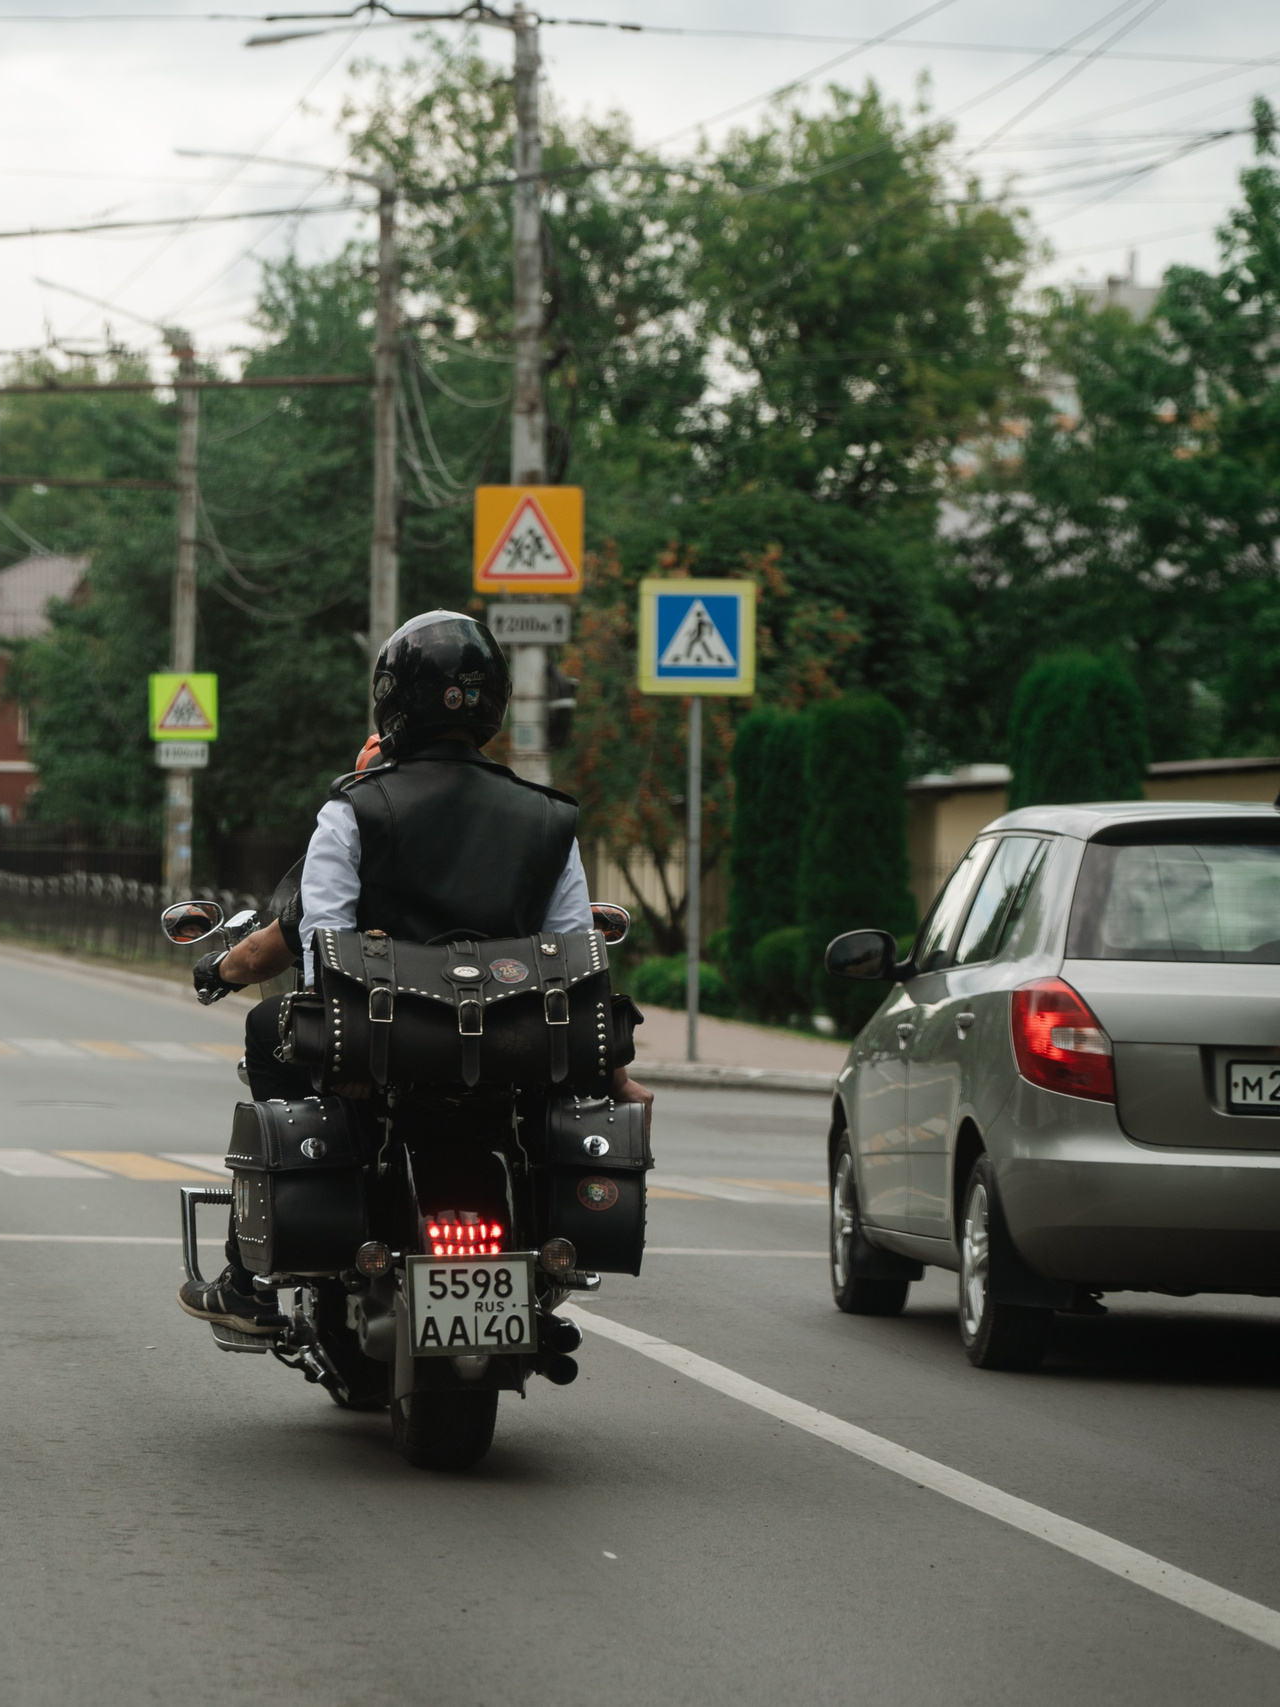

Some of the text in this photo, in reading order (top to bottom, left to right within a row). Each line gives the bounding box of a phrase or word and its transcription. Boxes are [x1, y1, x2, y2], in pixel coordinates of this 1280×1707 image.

[428, 1268, 513, 1300] 5598
[474, 1301, 505, 1313] RUS
[419, 1315, 525, 1347] AA 40
